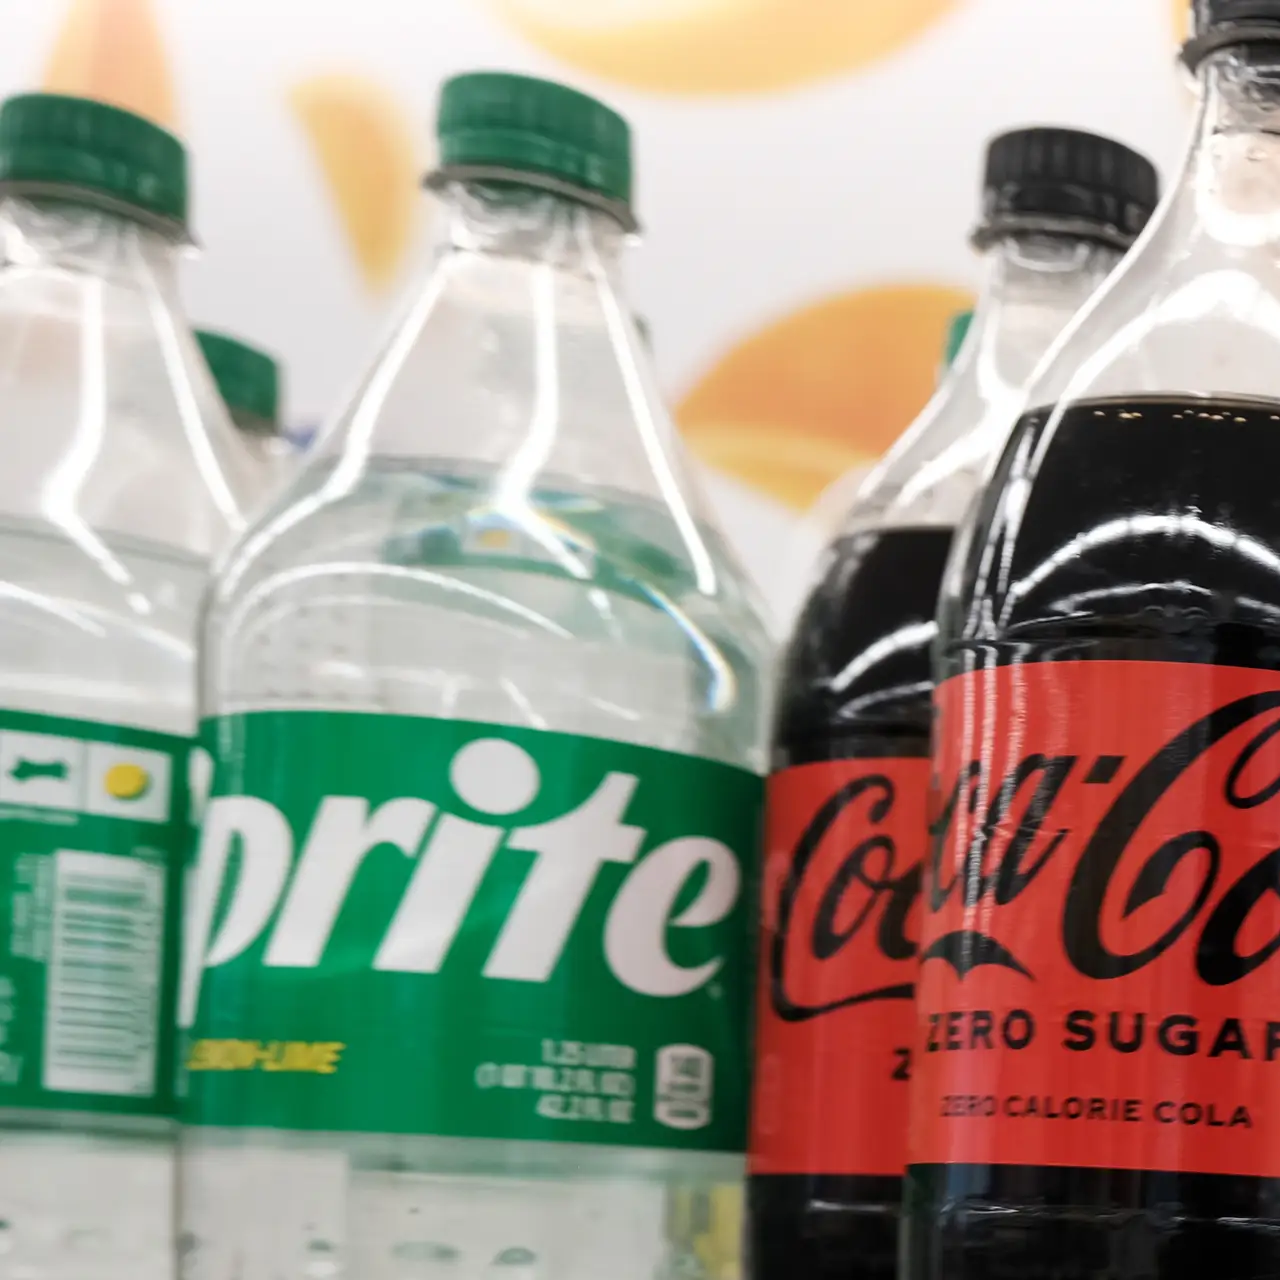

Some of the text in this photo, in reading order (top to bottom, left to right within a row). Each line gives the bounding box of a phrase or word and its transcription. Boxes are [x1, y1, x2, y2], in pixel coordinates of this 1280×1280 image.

[178, 738, 742, 1030] prite
[924, 1009, 1035, 1053] ZERO
[1003, 1094, 1144, 1123] CALORIE
[1153, 1100, 1254, 1129] COLA
